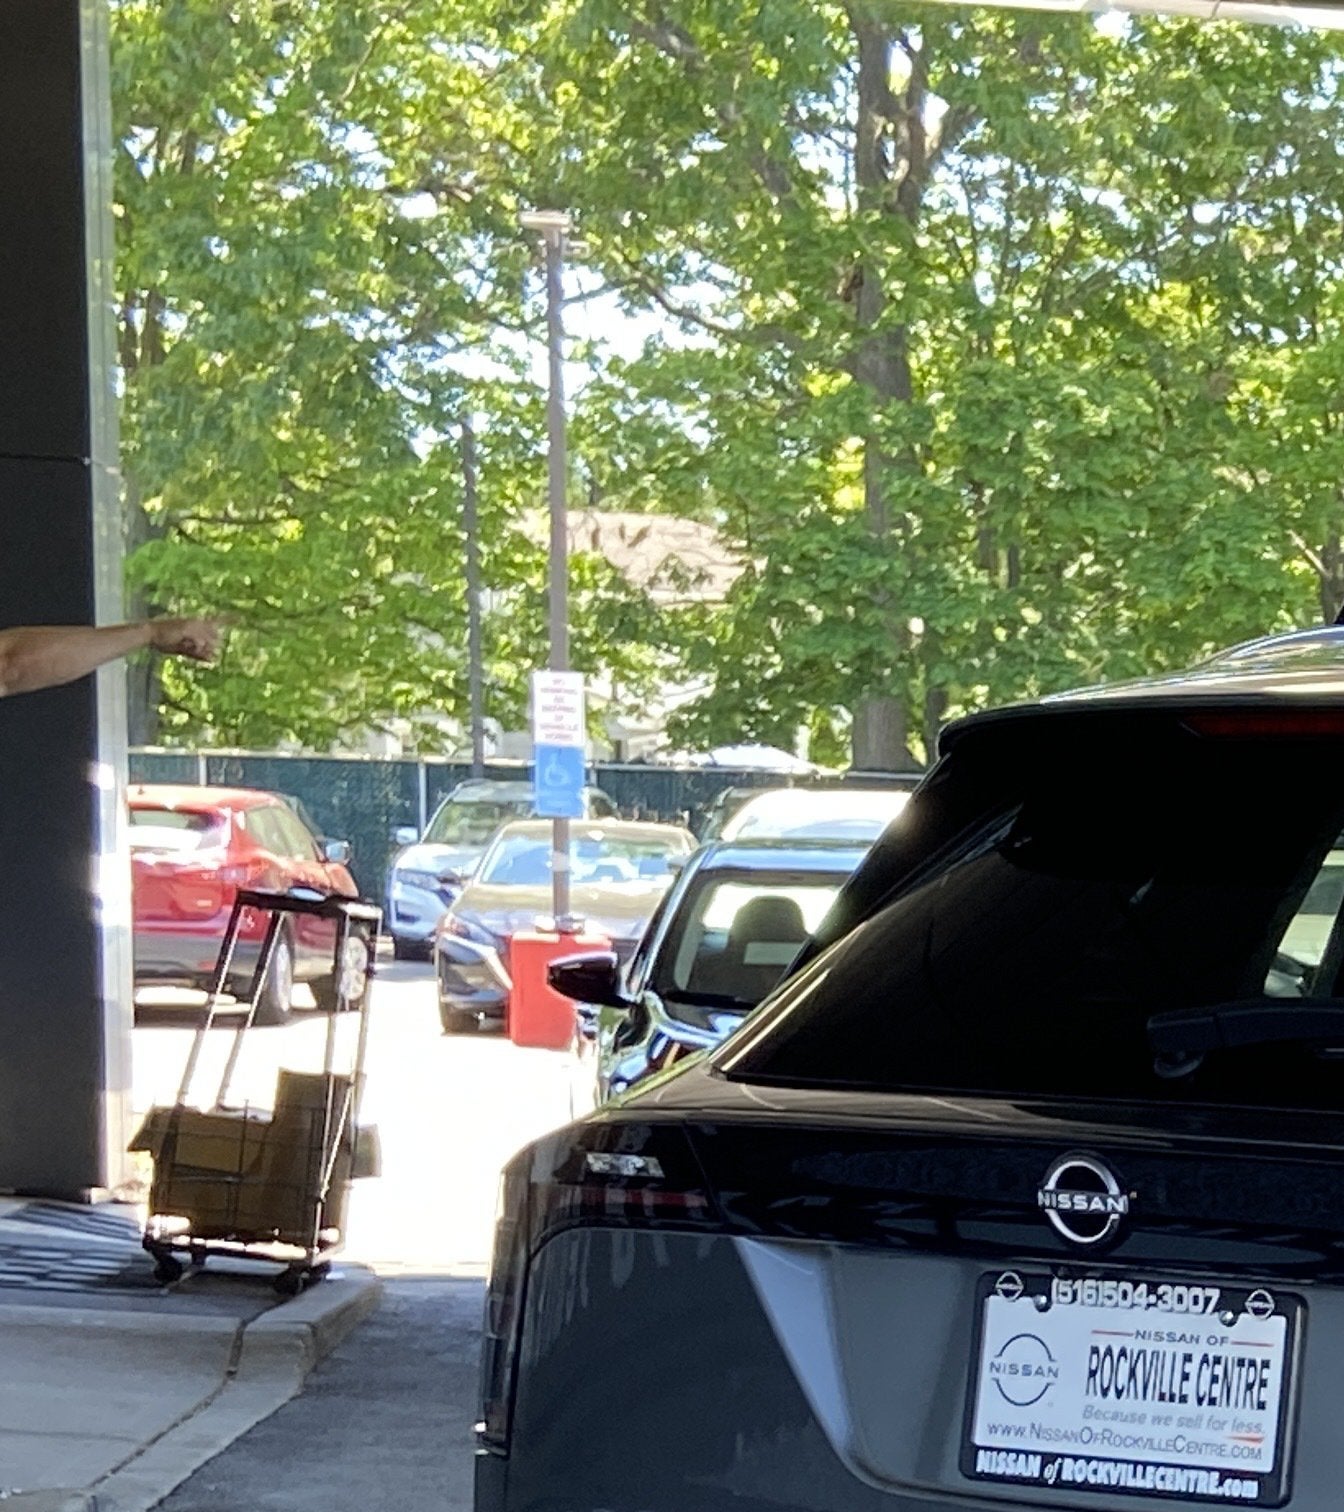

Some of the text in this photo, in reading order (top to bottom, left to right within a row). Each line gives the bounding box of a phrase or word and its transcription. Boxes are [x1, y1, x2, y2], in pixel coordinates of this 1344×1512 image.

[1038, 1189, 1128, 1215] NISSAN
[1134, 1329, 1230, 1347] NISSAN OF
[989, 1361, 1059, 1379] NISSAN
[1085, 1345, 1271, 1412] ROCKVILLE CENTRE
[1082, 1404, 1147, 1426] Because
[1150, 1413, 1173, 1427] we
[1176, 1412, 1203, 1430] sell
[1205, 1414, 1229, 1432] for
[976, 1449, 1259, 1498] NISSAN of ROCKVILLECENTRE.com
